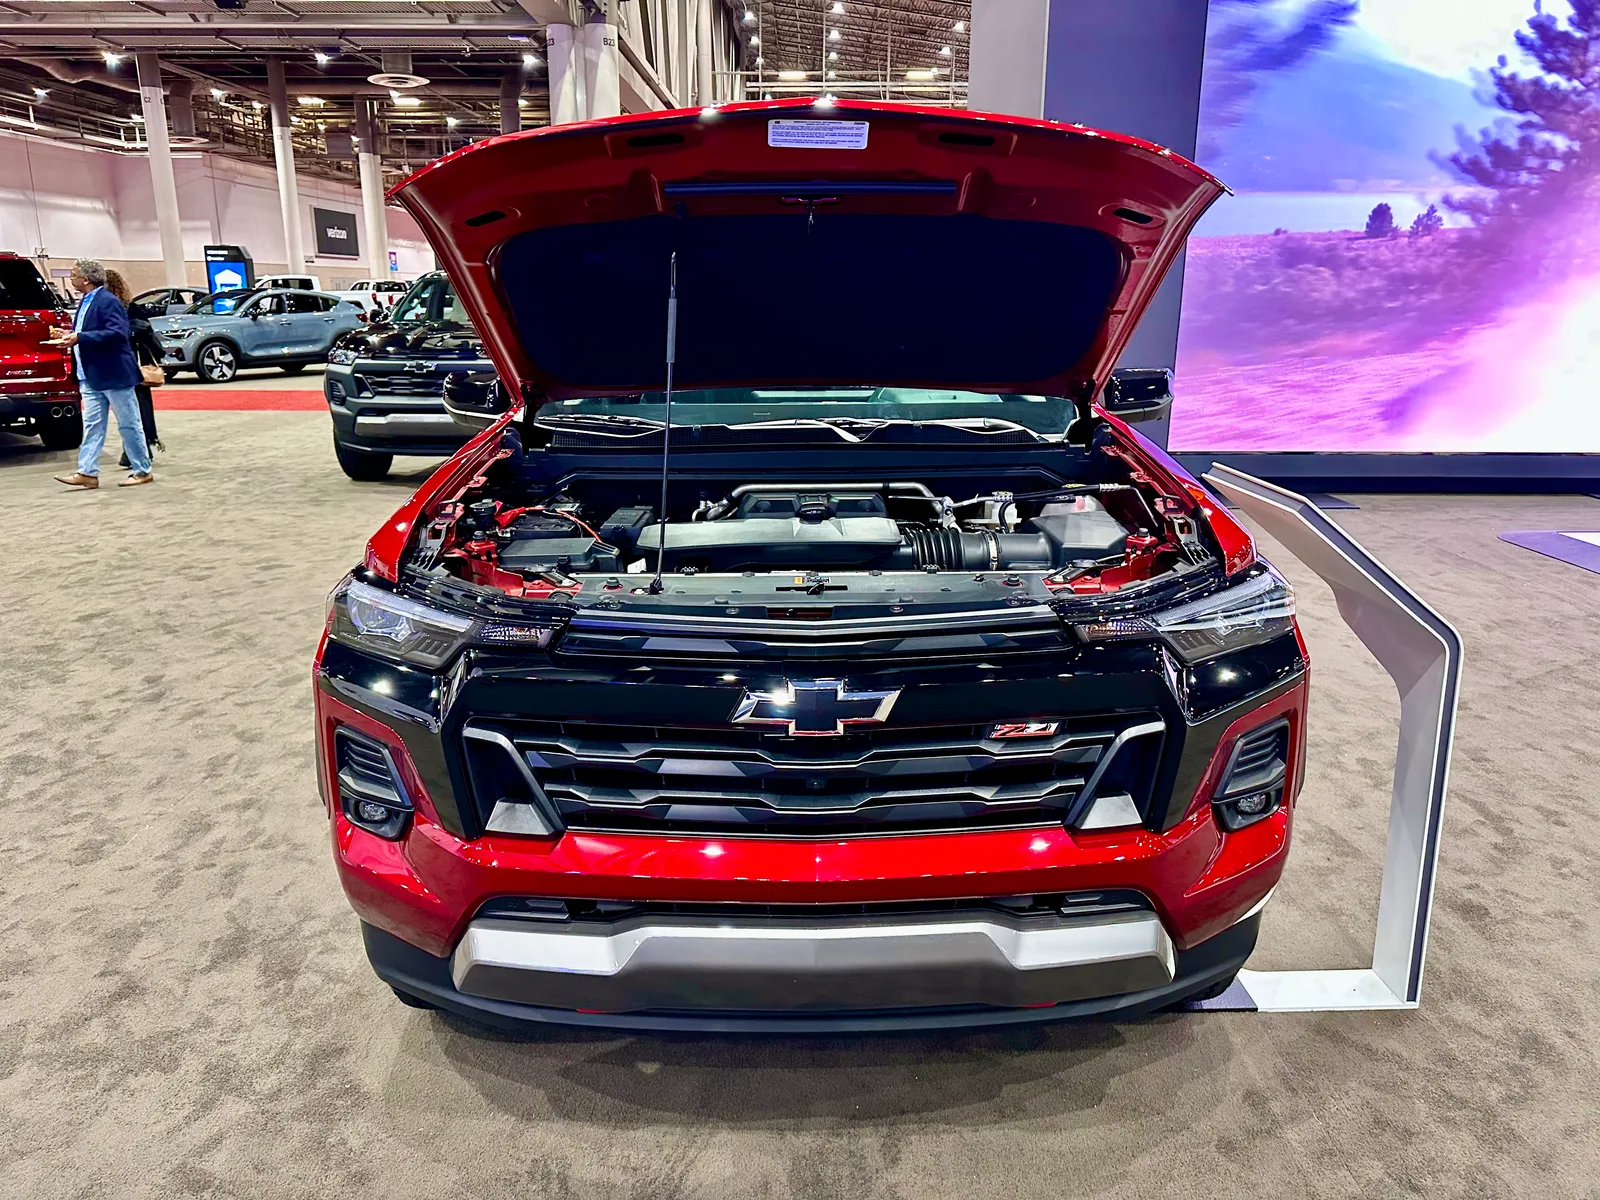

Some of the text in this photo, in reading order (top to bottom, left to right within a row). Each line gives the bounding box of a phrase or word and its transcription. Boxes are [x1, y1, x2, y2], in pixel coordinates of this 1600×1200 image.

[547, 38, 555, 46] 23
[603, 38, 616, 47] B23
[326, 226, 348, 240] verizon
